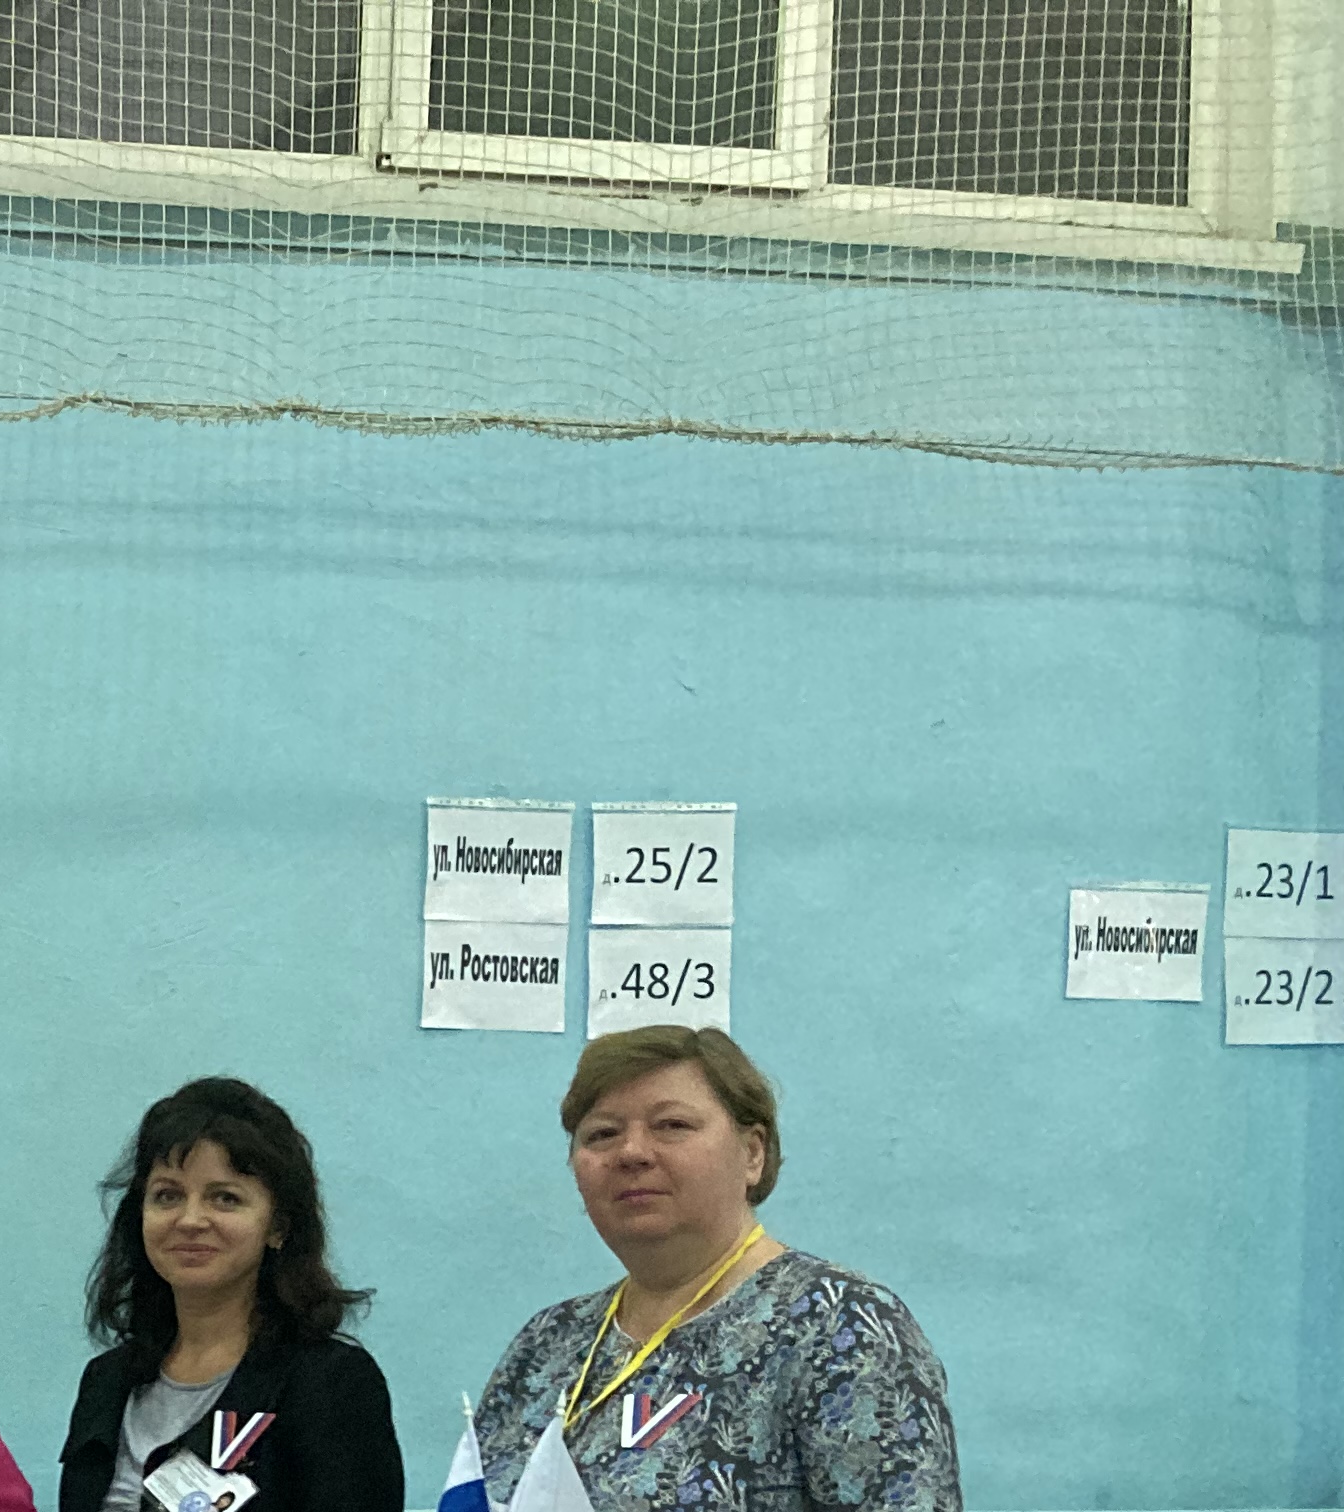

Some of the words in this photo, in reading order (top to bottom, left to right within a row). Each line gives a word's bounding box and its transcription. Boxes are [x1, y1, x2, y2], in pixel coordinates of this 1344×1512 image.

[433, 844, 452, 881] ул.
[455, 836, 563, 884] Новосибирская
[602, 843, 719, 891] д.25/2
[1234, 860, 1335, 906] д.23/1
[1074, 924, 1092, 960] ул.
[430, 952, 455, 989] ул.
[459, 944, 559, 985] Ростовская
[599, 958, 716, 1007] д.48/3
[1234, 966, 1335, 1011] д.23/2
